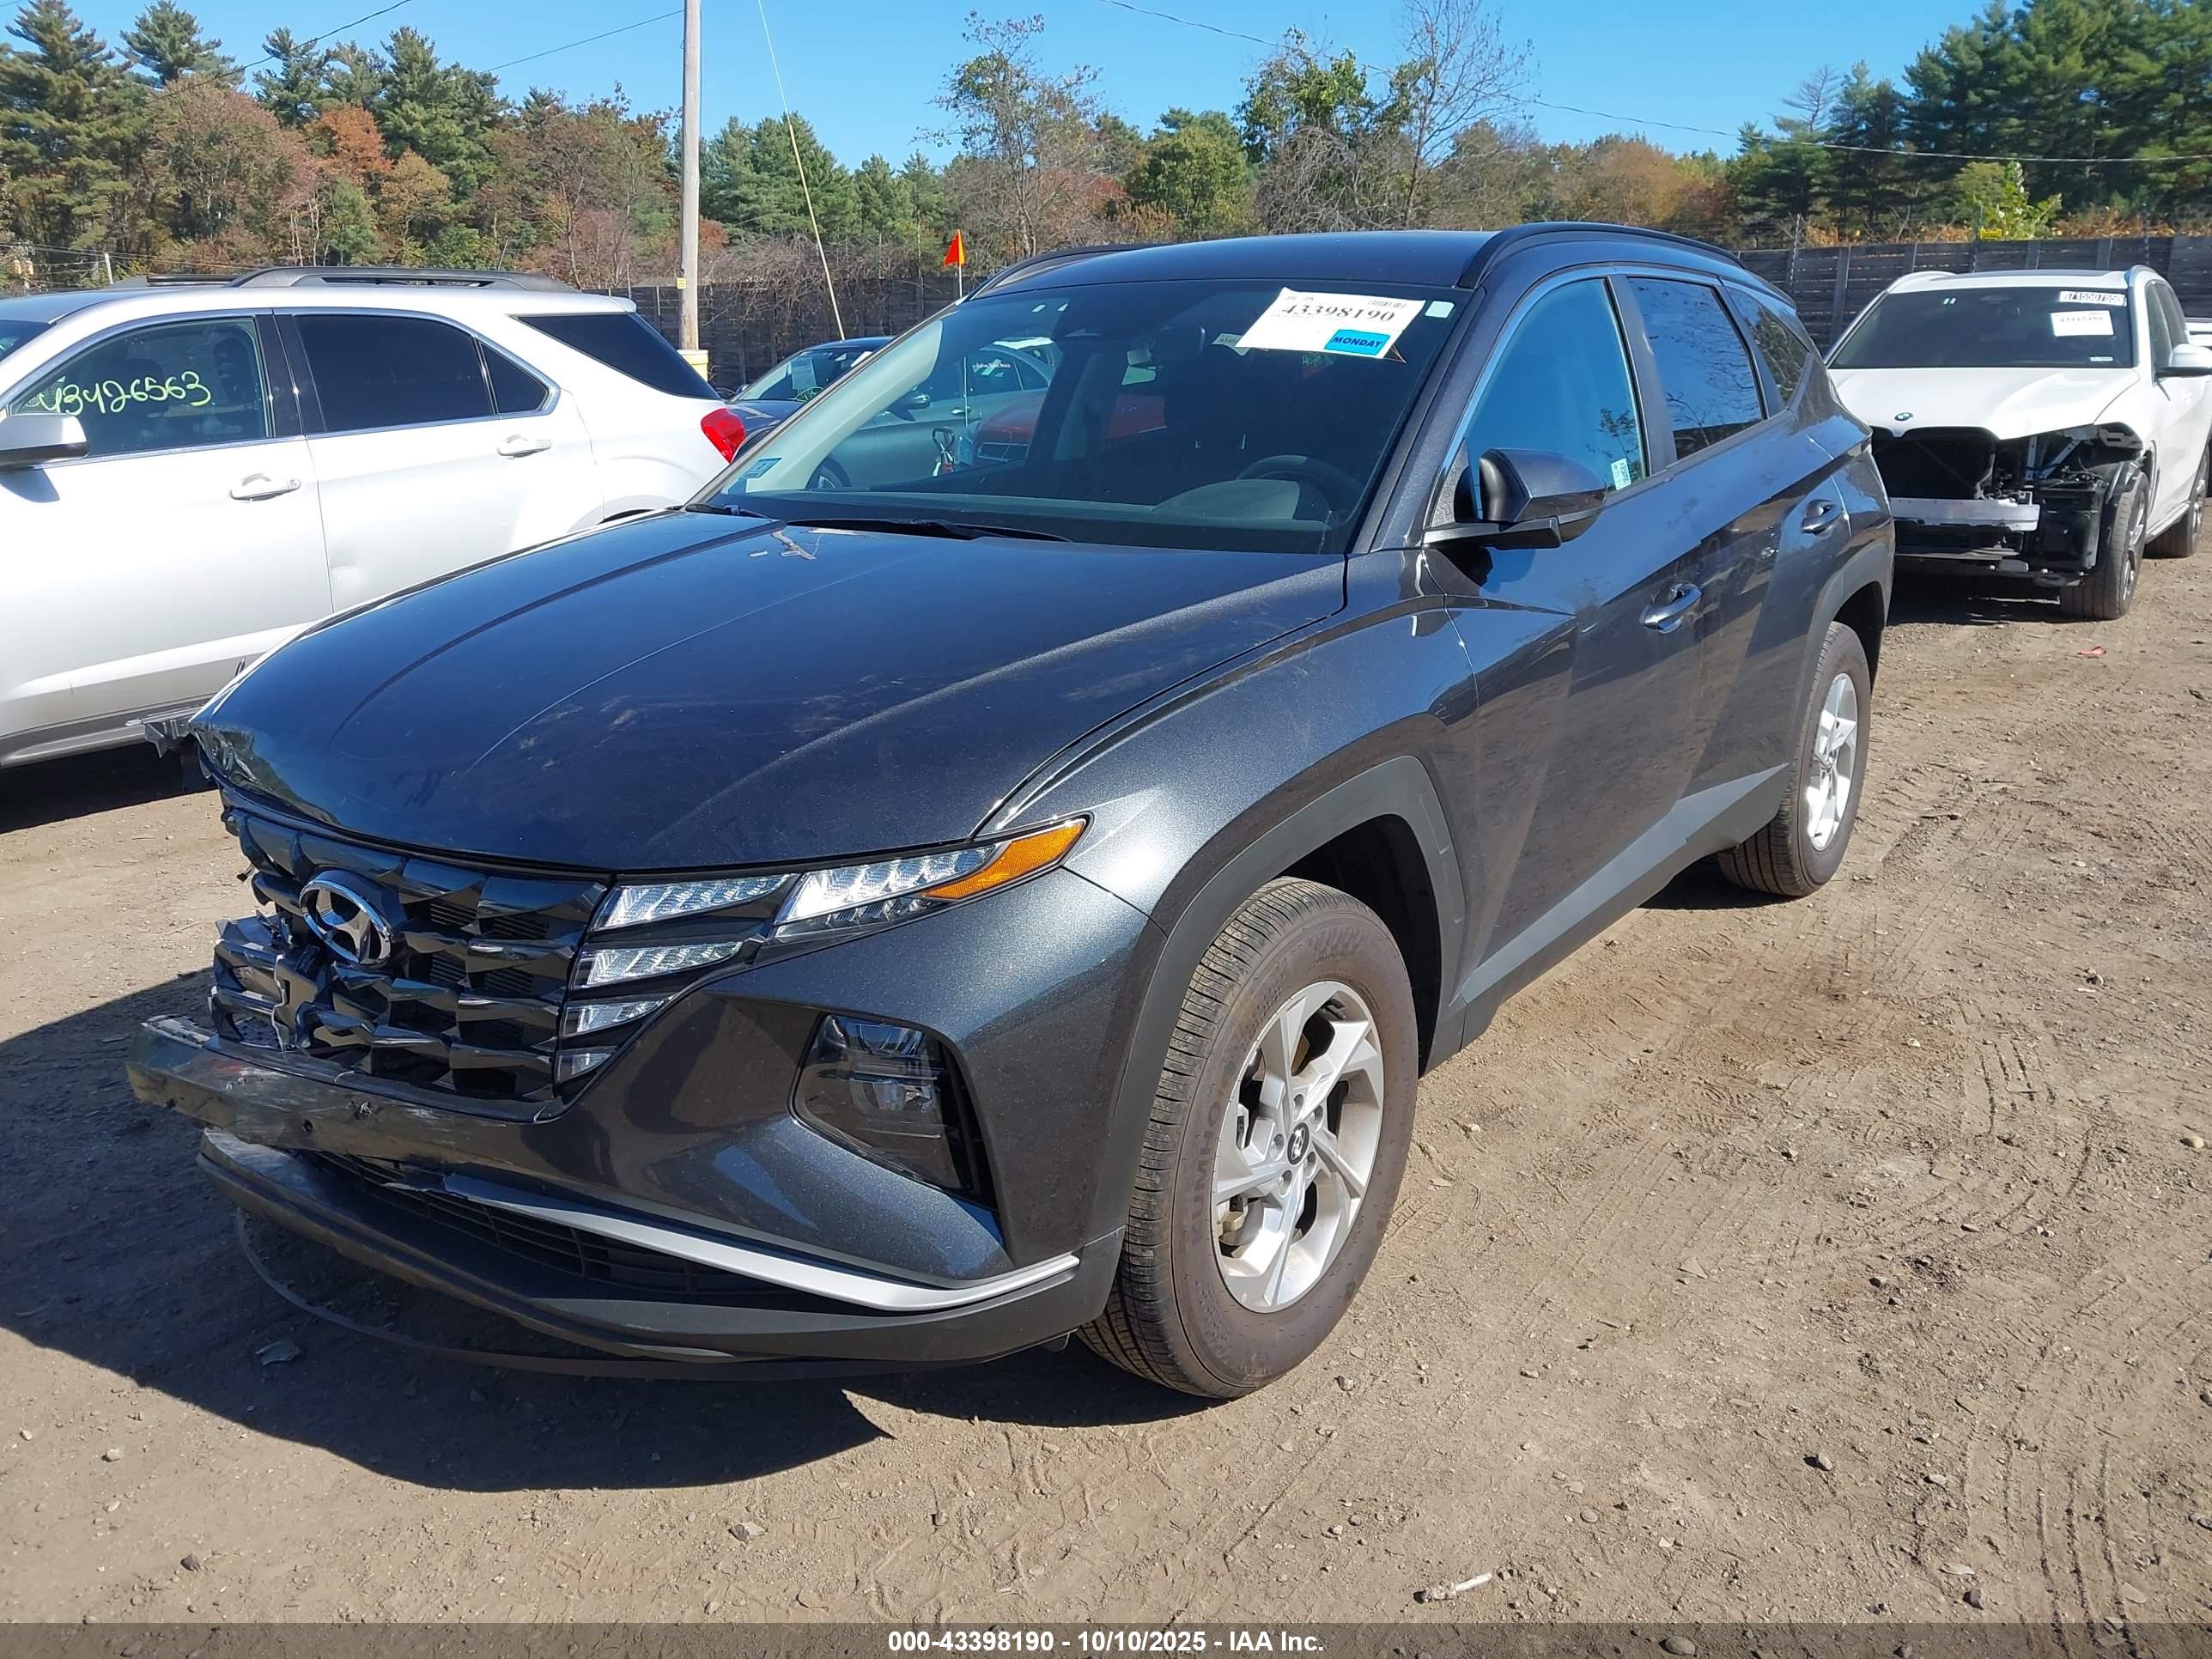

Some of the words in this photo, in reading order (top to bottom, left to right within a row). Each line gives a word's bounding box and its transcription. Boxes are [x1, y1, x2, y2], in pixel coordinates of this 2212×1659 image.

[1282, 304, 1395, 322] 43398190
[1332, 336, 1382, 348] MONDAY
[1191, 1100, 1220, 1245] KUMHO
